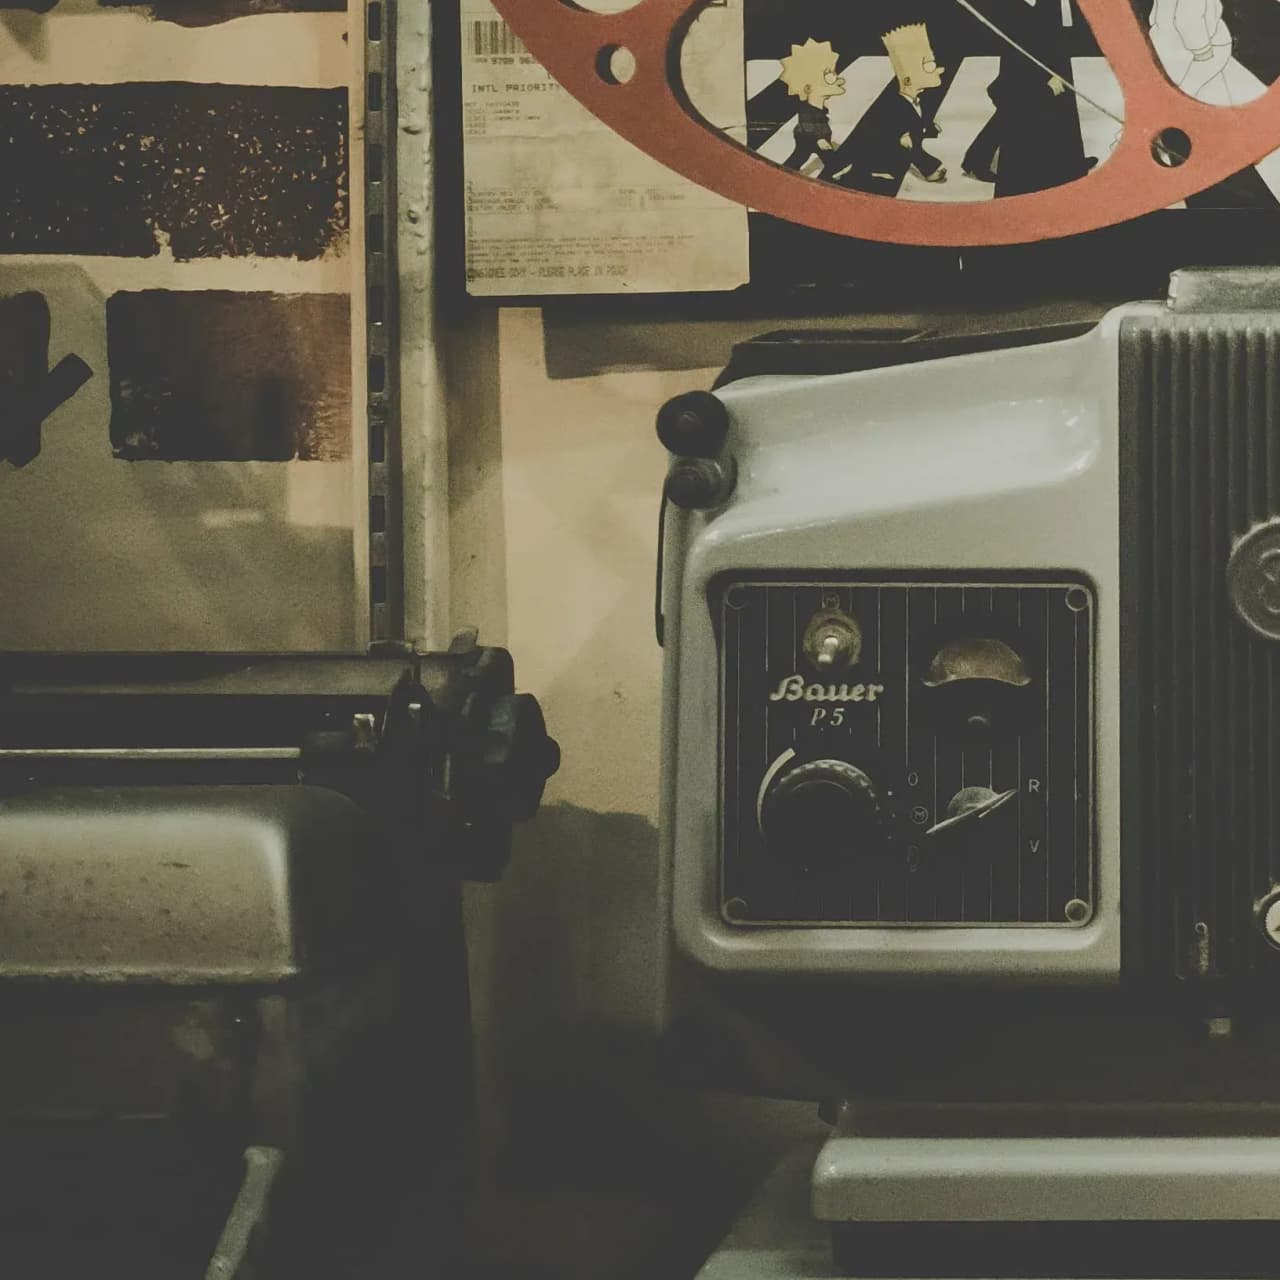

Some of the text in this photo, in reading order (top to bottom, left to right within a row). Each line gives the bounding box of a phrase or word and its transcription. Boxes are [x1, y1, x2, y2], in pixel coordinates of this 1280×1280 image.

[472, 84, 499, 94] INTL
[769, 673, 885, 703] Bauer
[1028, 778, 1040, 794] R
